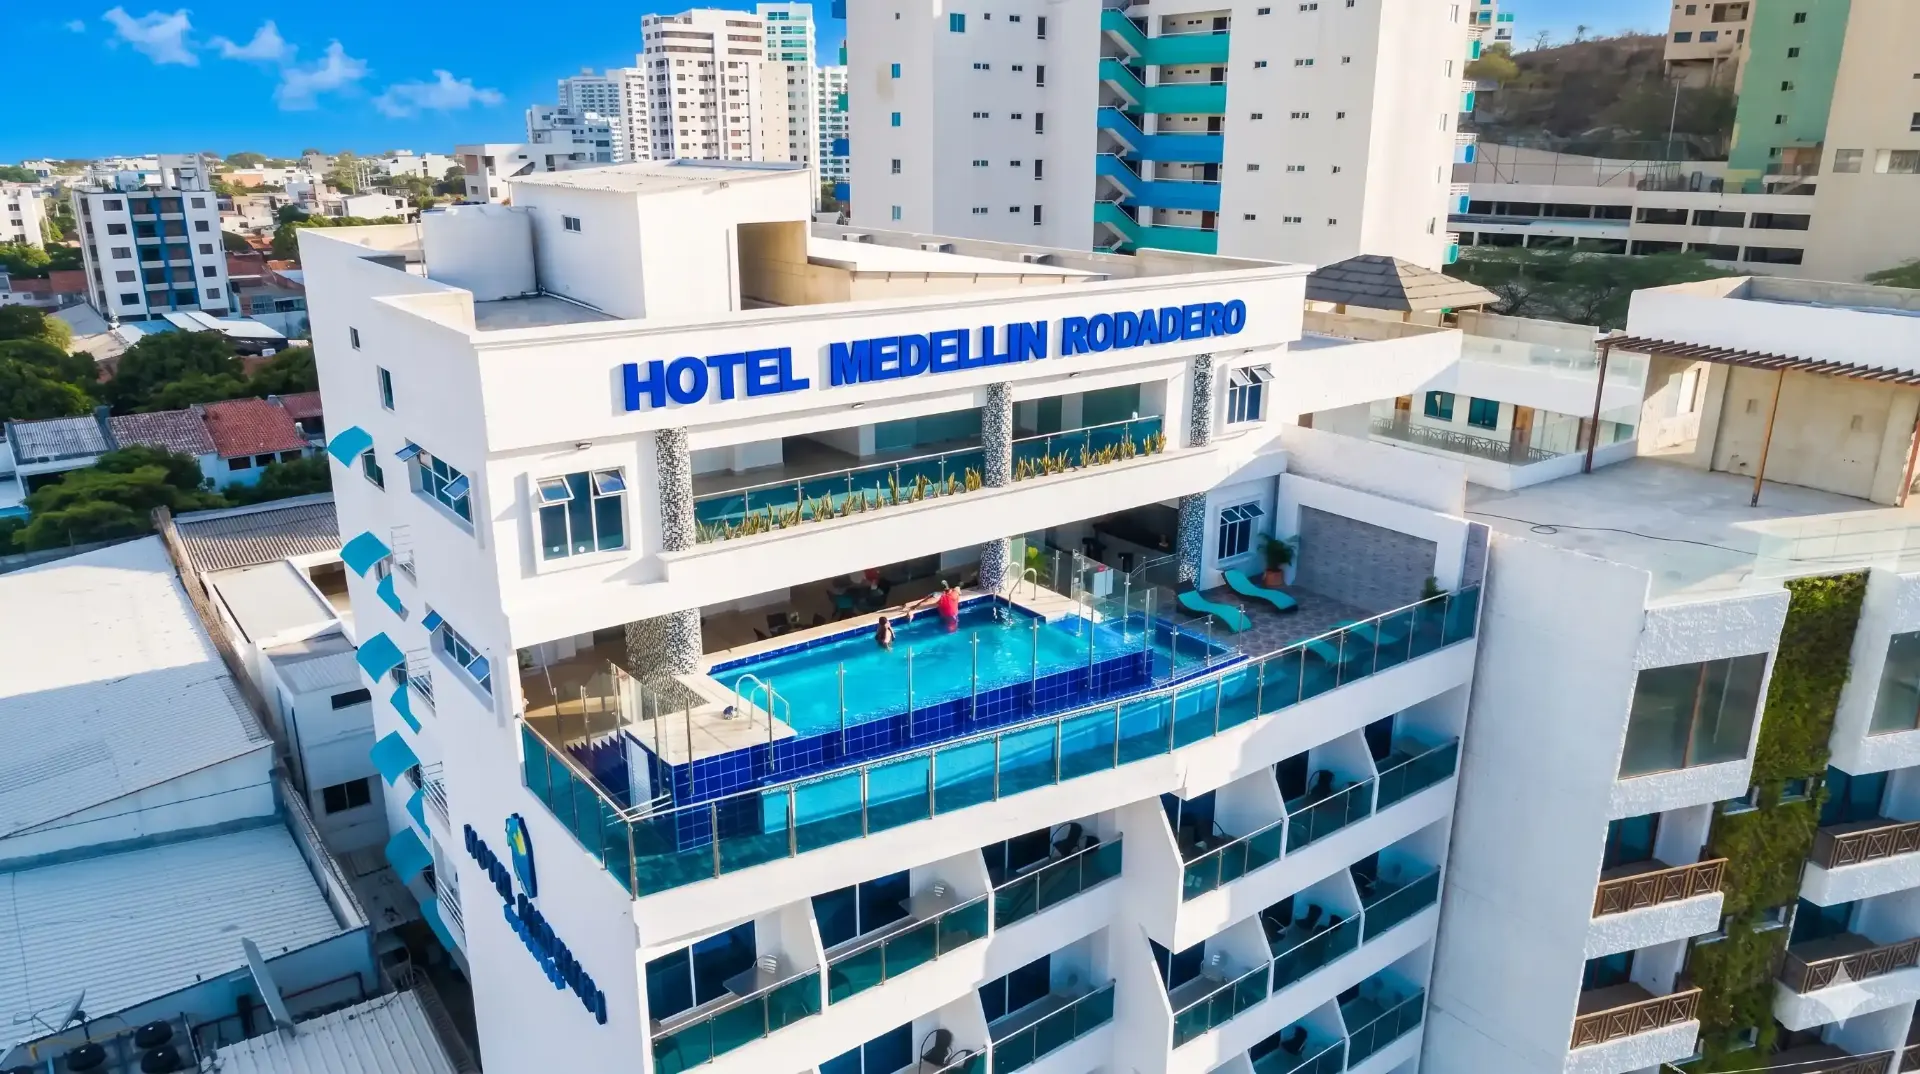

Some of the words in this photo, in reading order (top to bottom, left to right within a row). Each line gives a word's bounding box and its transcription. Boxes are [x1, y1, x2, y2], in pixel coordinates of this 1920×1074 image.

[622, 346, 810, 412] HOTEL
[829, 320, 1048, 387] MEDELLIN
[1061, 299, 1247, 356] RODADERO
